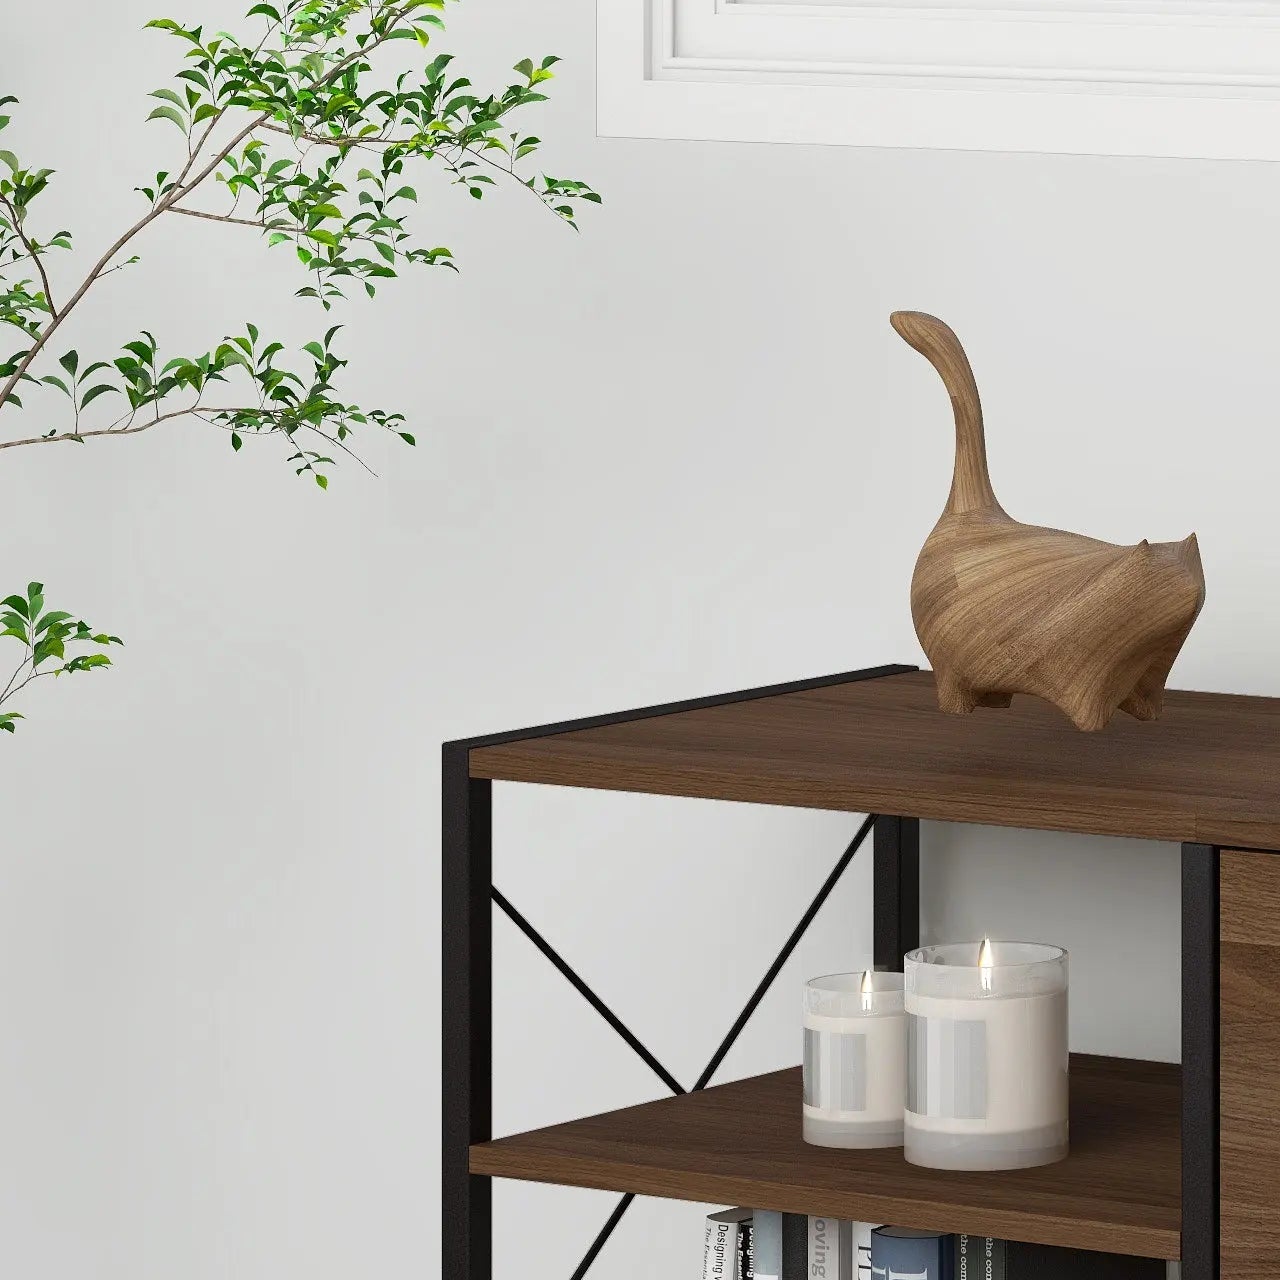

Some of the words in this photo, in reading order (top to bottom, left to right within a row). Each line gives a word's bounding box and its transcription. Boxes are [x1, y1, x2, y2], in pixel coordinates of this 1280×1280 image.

[712, 1224, 729, 1274] Designing
[812, 1219, 830, 1279] oving
[960, 1235, 968, 1254] the
[985, 1237, 993, 1258] the
